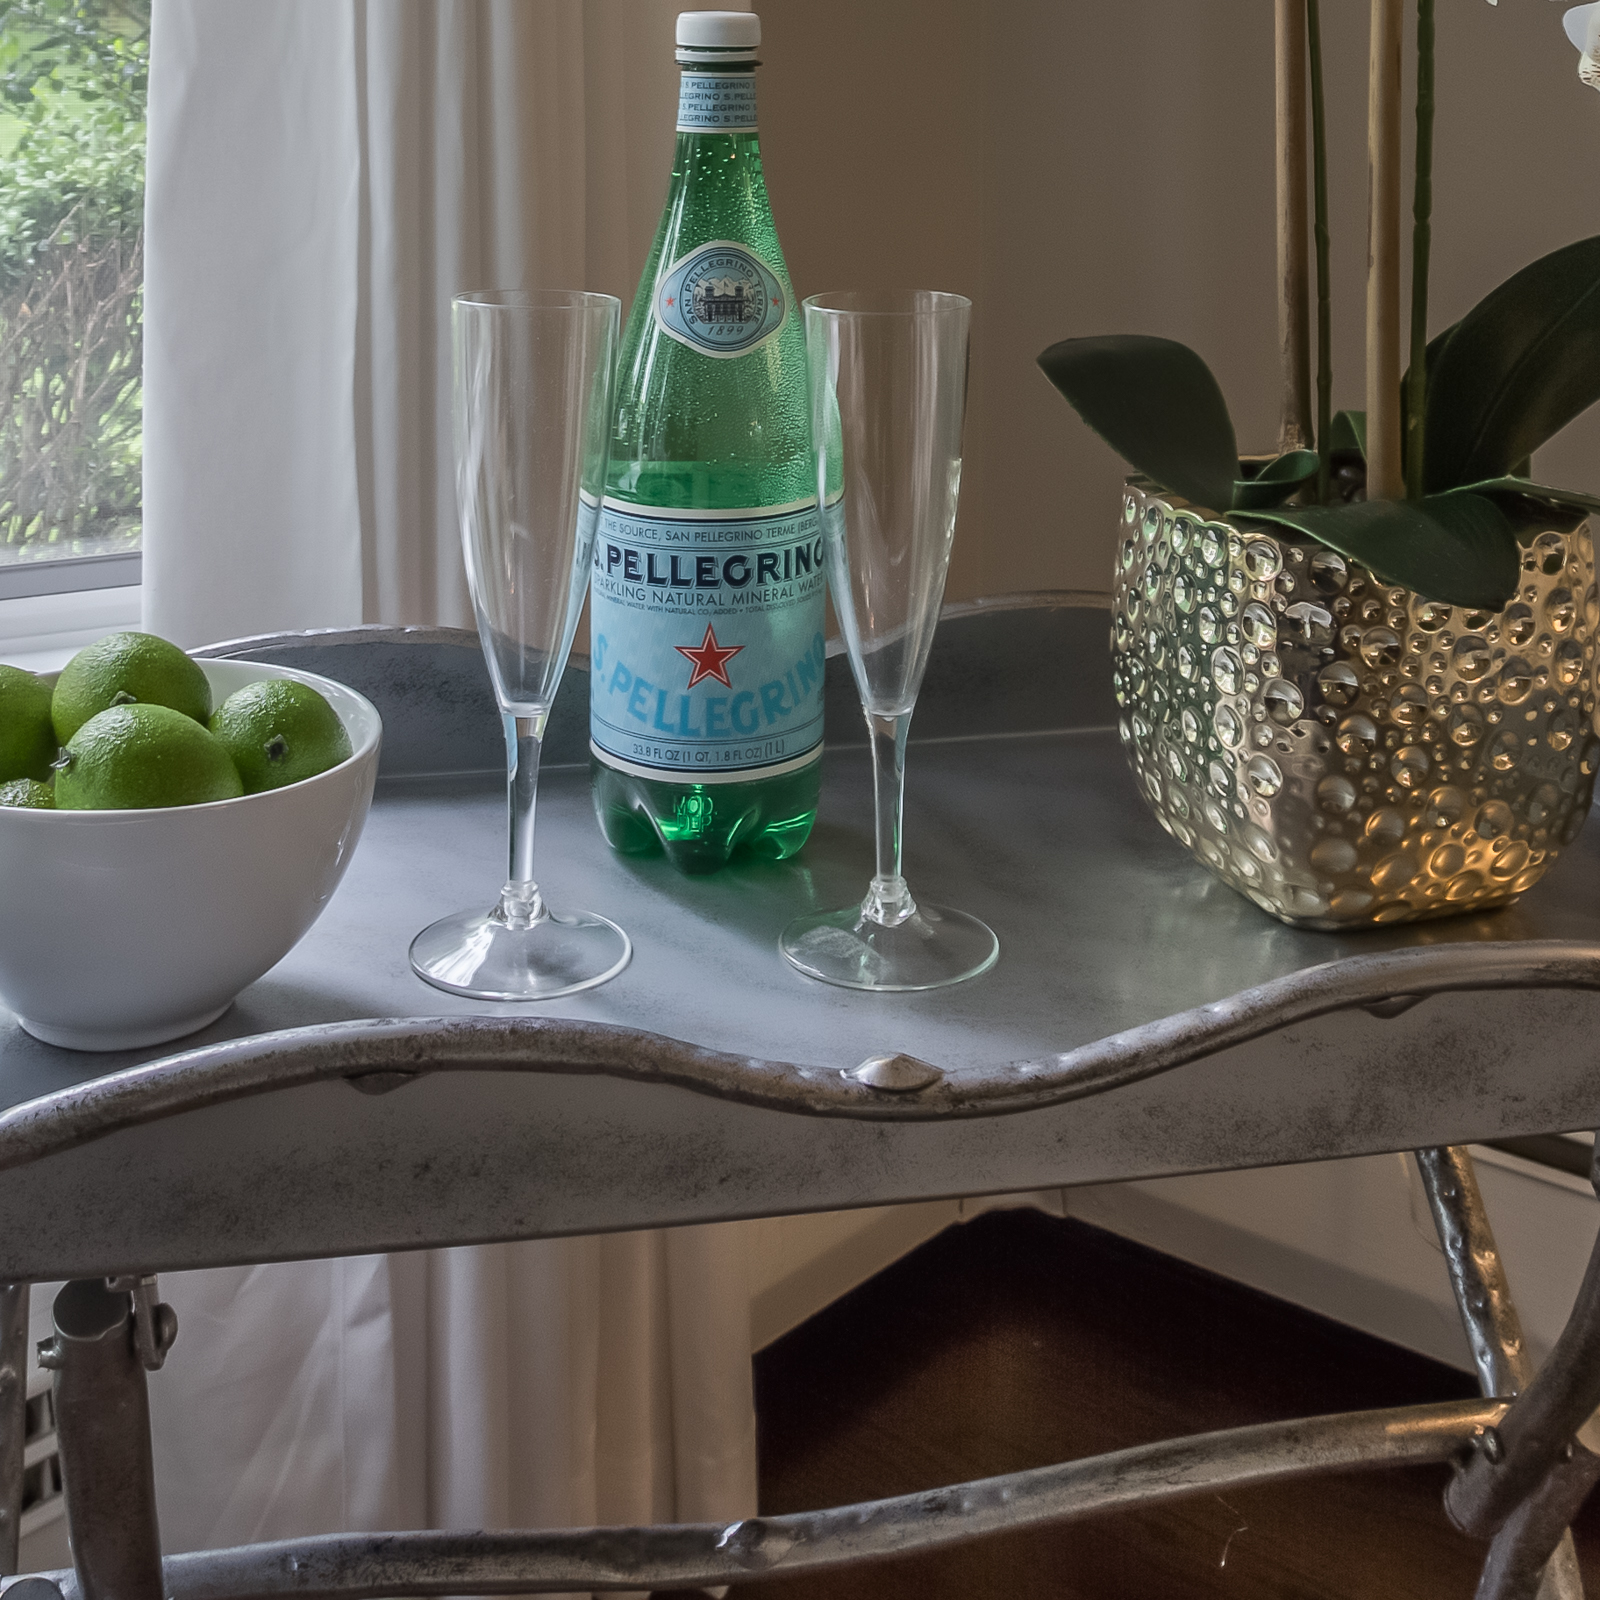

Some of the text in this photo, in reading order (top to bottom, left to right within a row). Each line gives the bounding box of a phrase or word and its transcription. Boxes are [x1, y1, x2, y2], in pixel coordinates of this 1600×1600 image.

[684, 258, 763, 325] SAN PELLEGRINO TERME
[708, 325, 744, 336] 1899
[605, 518, 617, 532] THE
[619, 523, 662, 542] SOURCE,
[665, 530, 690, 542] SAN
[694, 529, 763, 543] PELLEGRINO
[766, 523, 796, 539] TERME
[652, 589, 725, 606] NATURAL
[731, 580, 794, 606] MINERAL
[647, 604, 663, 613] WITH
[664, 606, 696, 616] NATURAL
[745, 605, 765, 614] TOTAL
[633, 743, 651, 757] 33.8
[653, 748, 664, 759] FL
[665, 750, 680, 761] OZ
[682, 750, 691, 763] (1
[715, 751, 730, 762] 1.8
[732, 751, 744, 761] FL
[745, 749, 762, 761] OZ)
